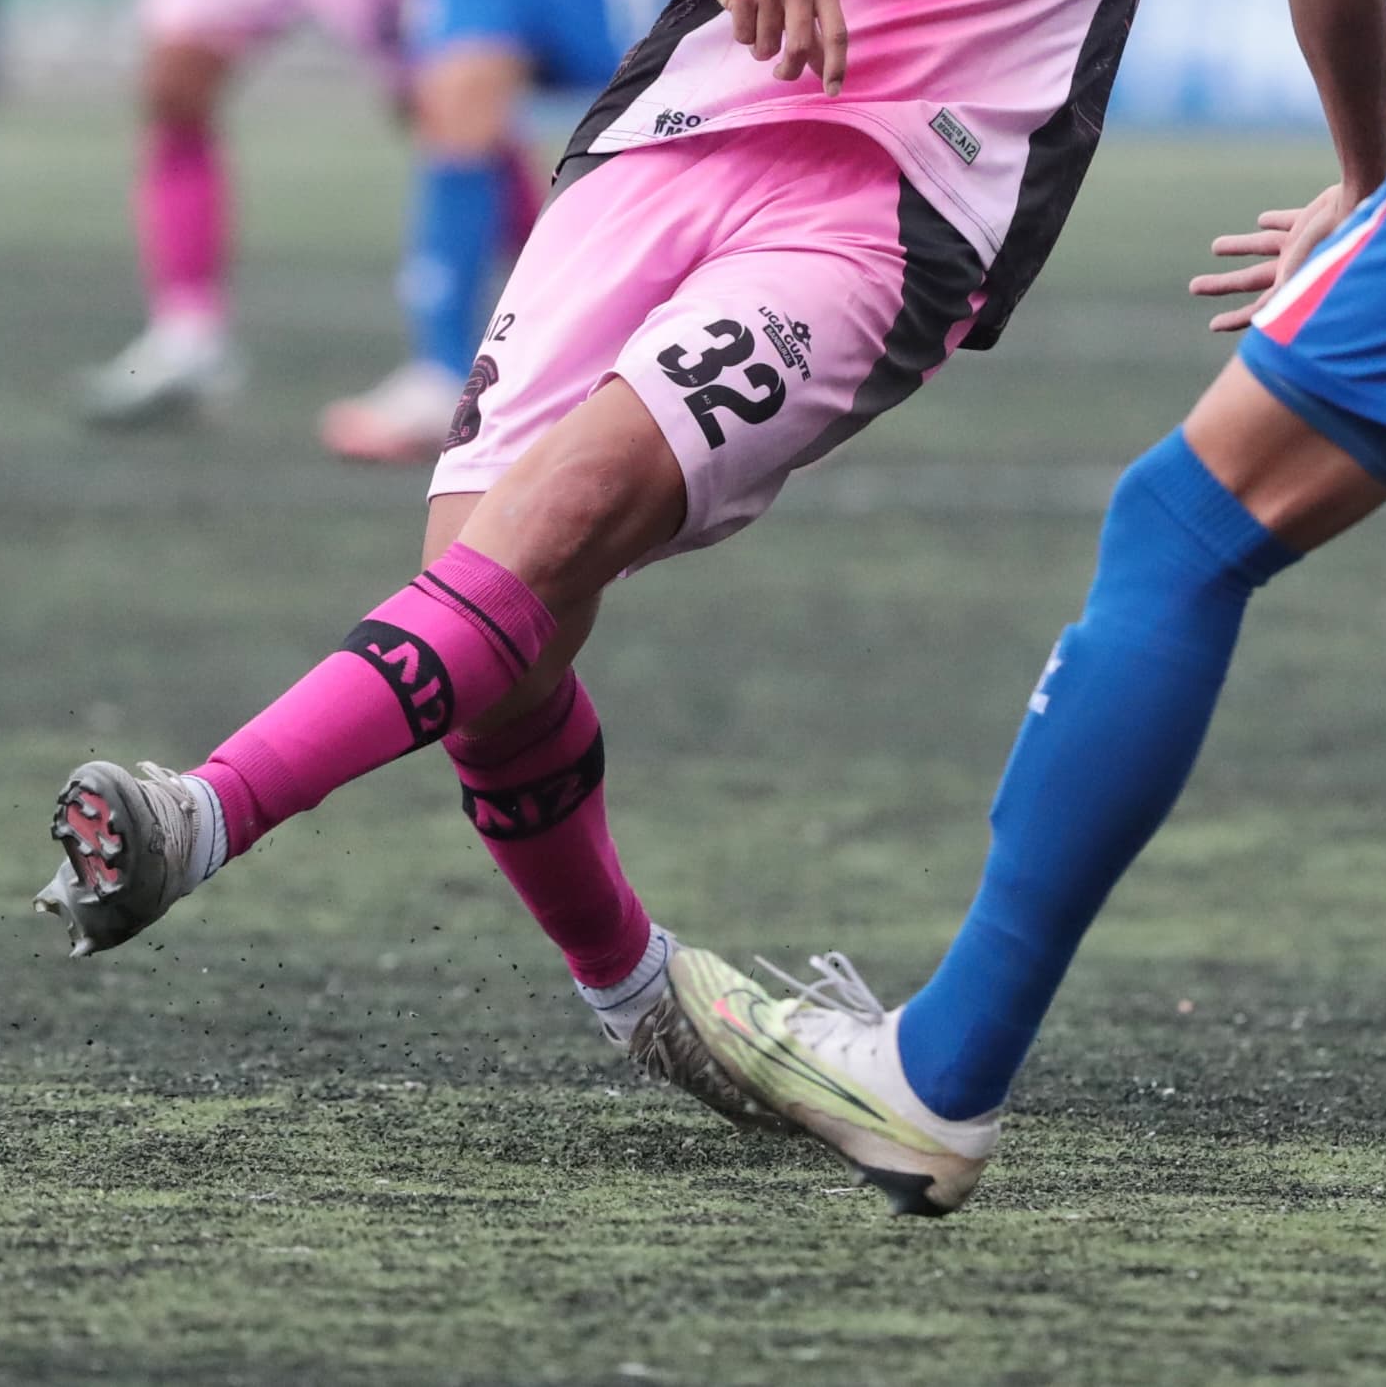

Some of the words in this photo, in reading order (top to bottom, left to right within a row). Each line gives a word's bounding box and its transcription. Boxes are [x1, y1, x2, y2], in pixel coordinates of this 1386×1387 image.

[653, 108, 711, 135] #SO
[758, 306, 785, 334] LIGA
[783, 333, 812, 382] GUATE
[656, 319, 786, 450] 32
